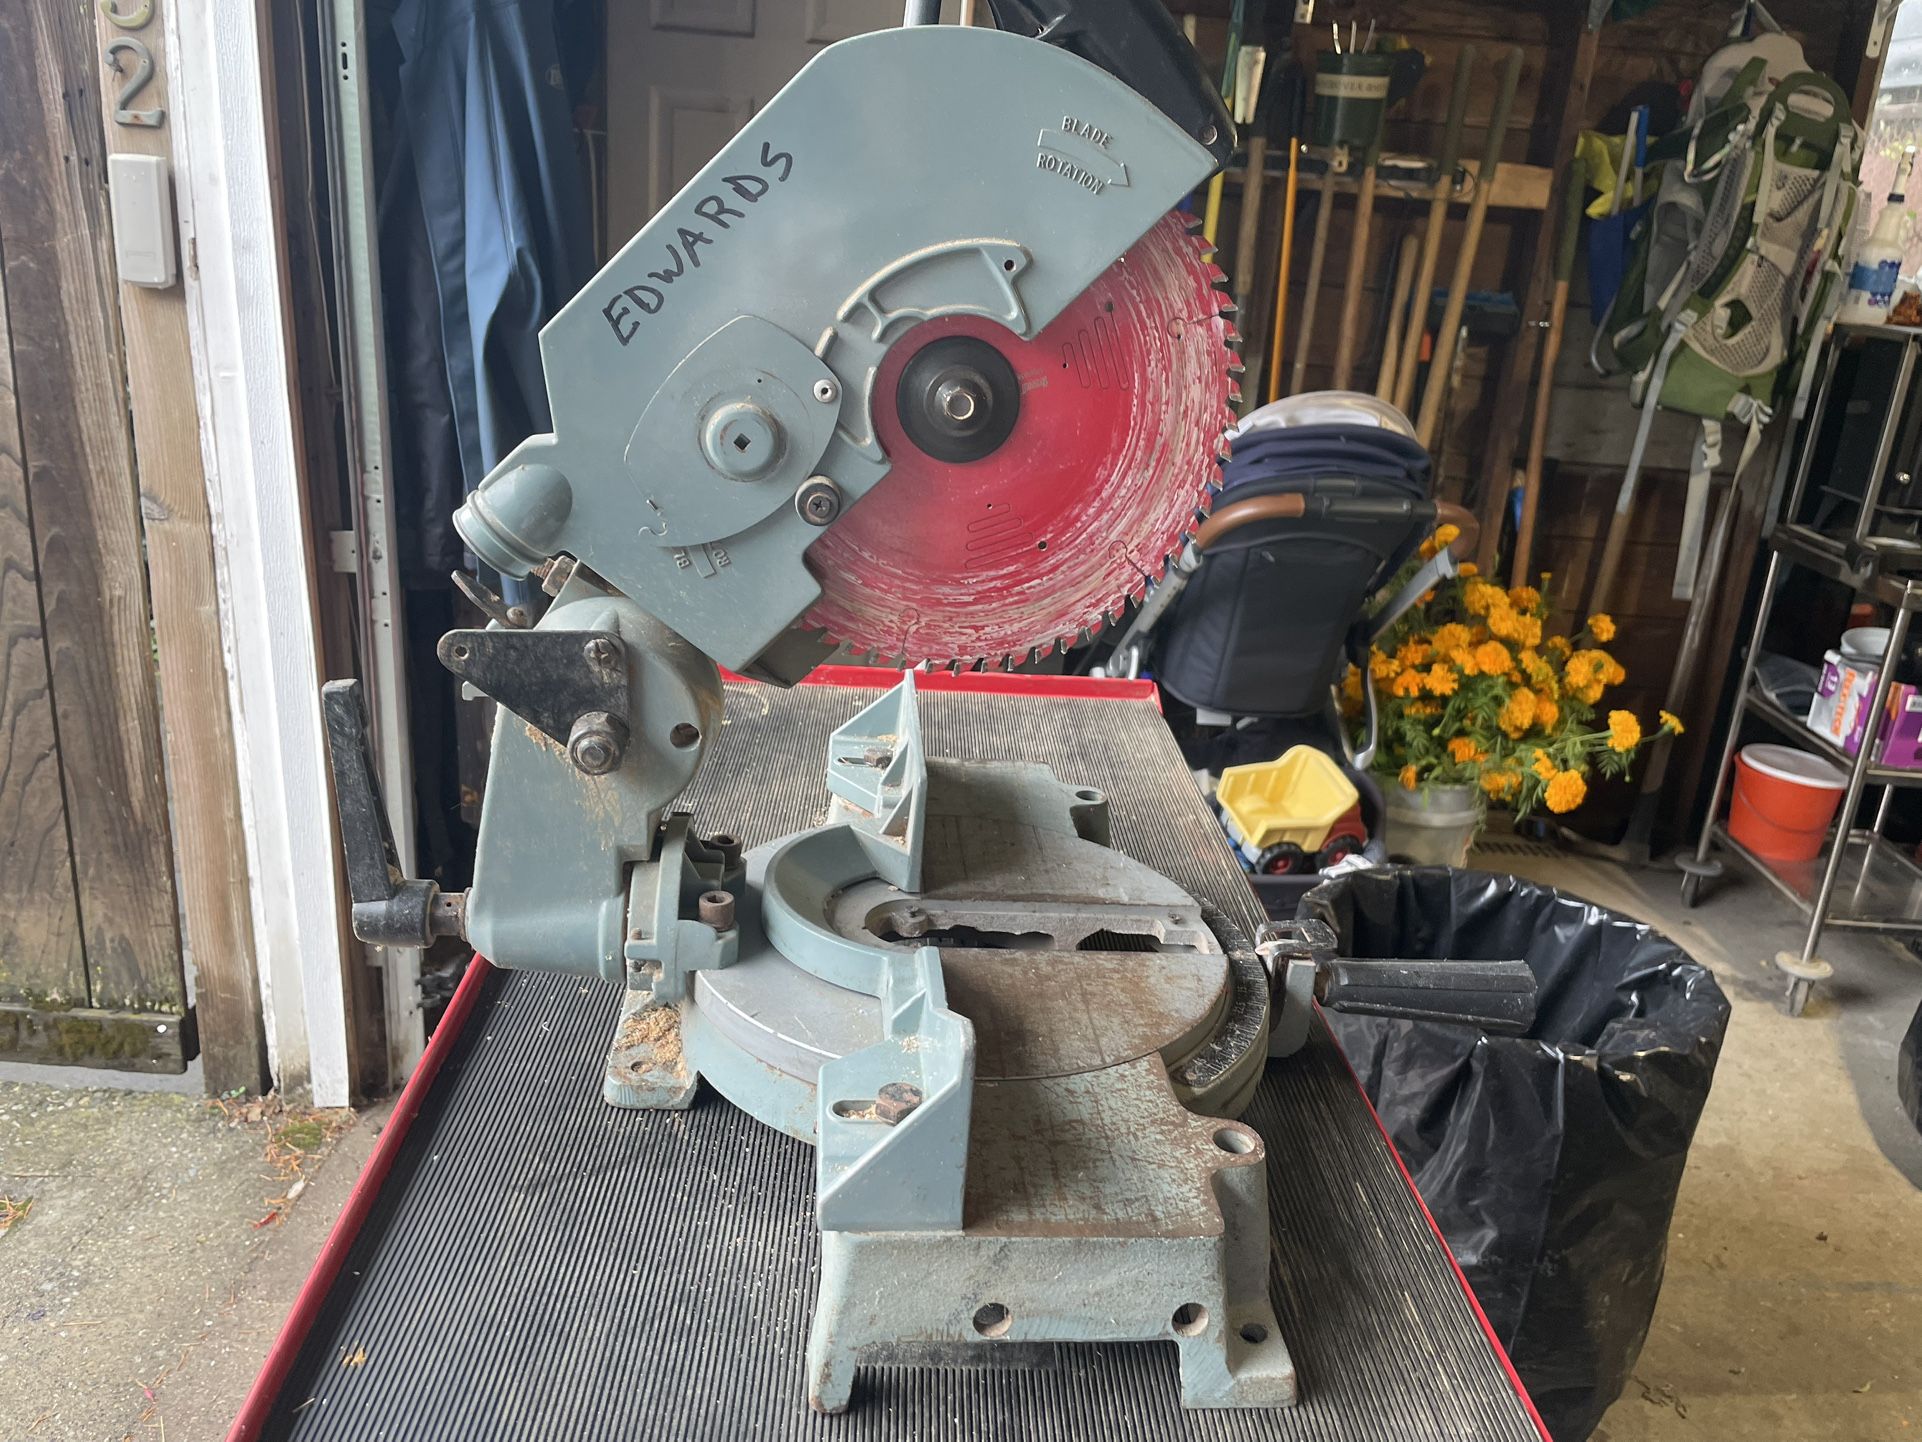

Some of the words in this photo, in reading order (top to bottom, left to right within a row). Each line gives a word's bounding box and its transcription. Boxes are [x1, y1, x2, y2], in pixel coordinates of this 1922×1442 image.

[1061, 115, 1114, 150] BLADE
[1036, 152, 1104, 195] ROTATION
[602, 141, 793, 346] EDWARDS
